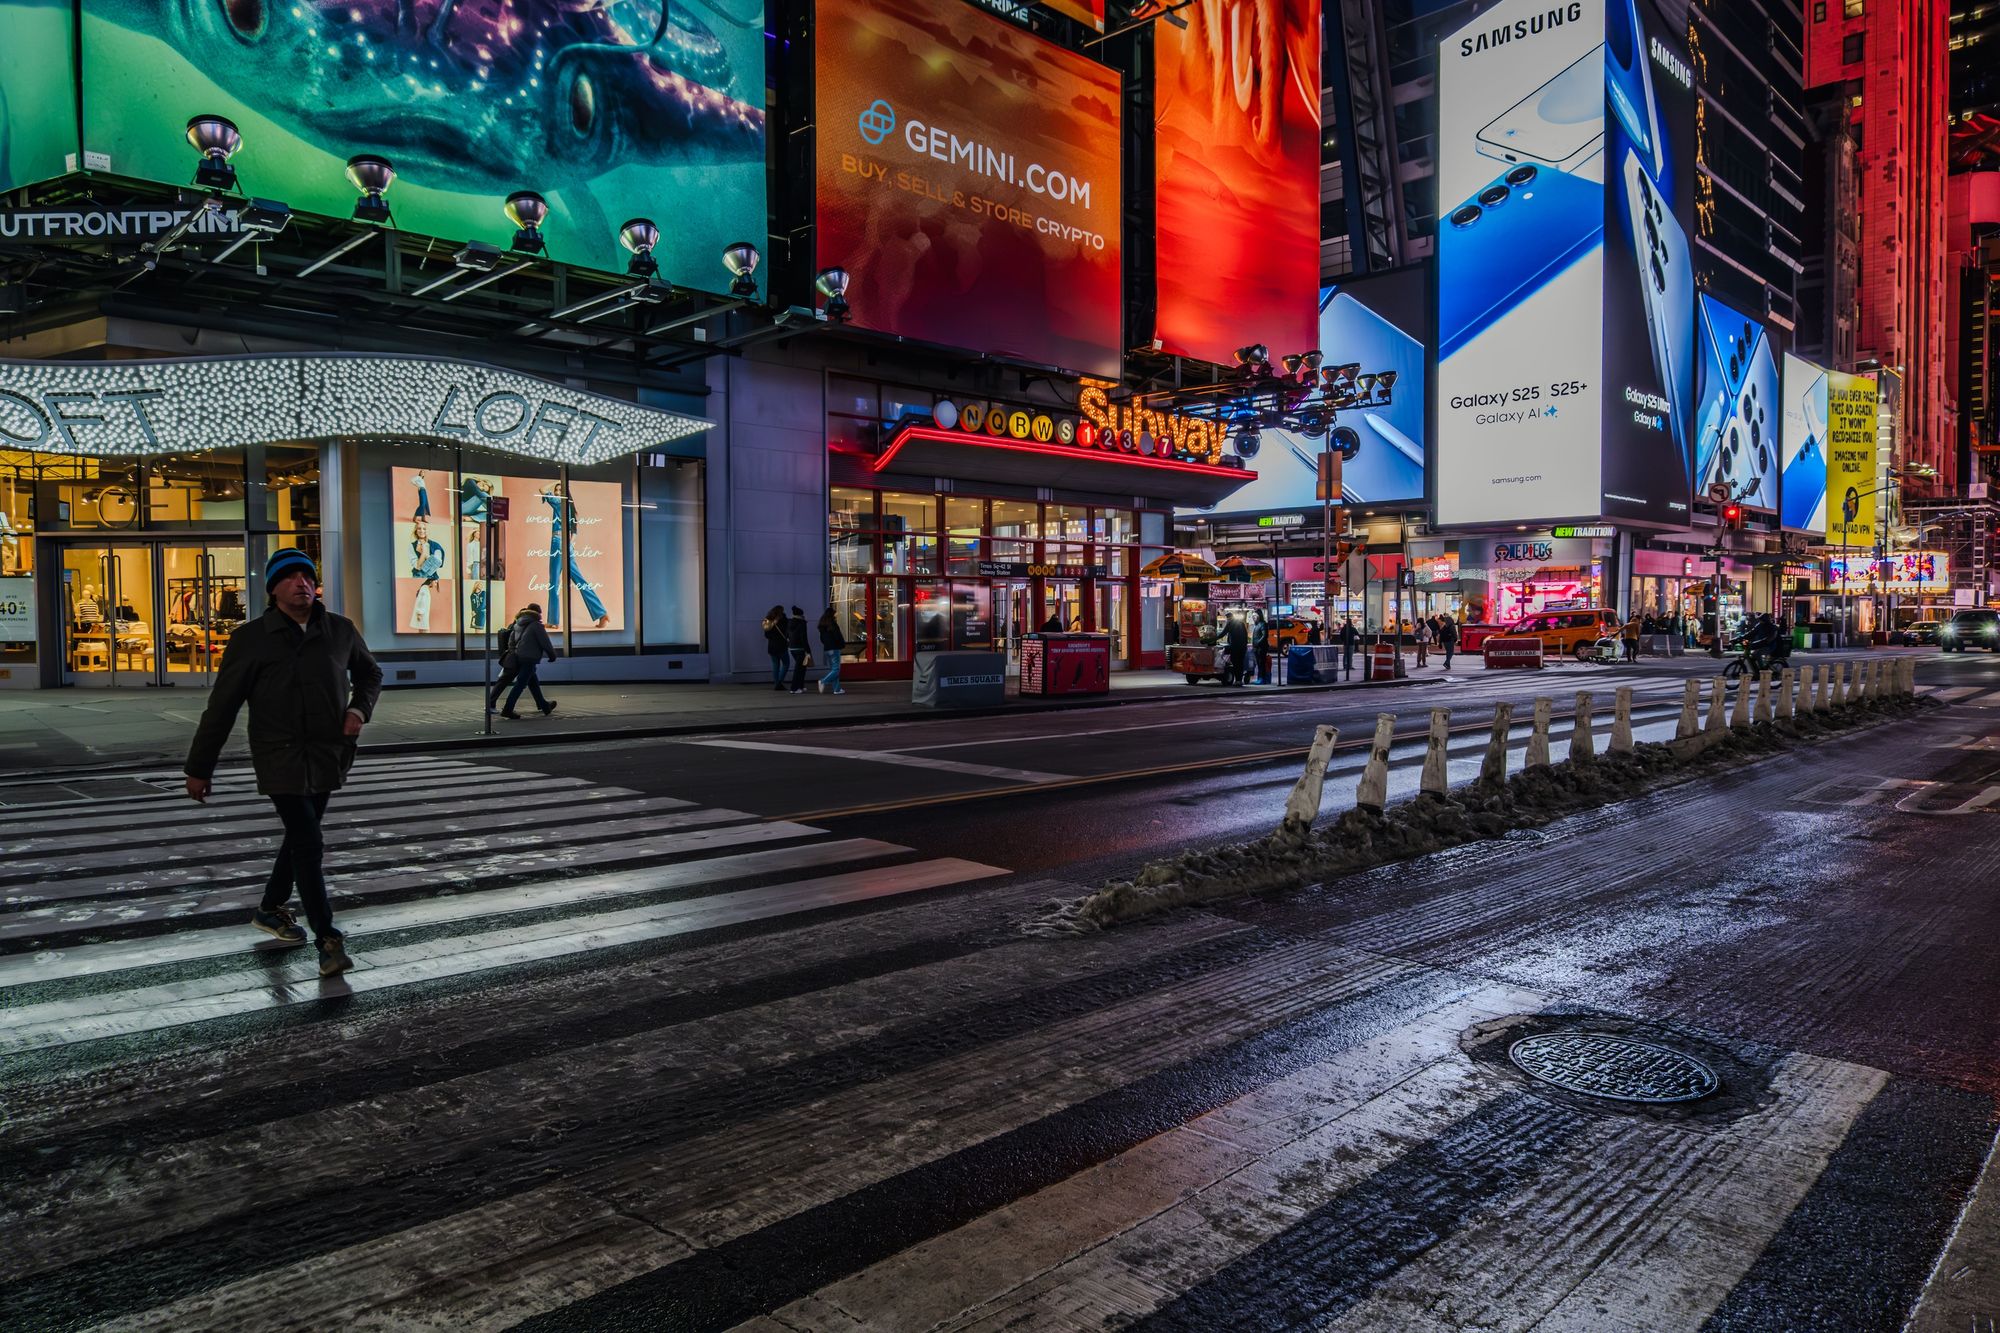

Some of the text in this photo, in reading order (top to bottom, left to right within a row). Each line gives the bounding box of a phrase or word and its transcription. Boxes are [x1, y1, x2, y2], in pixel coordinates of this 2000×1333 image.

[1461, 2, 1582, 57] SAMSUNG
[1651, 37, 1692, 89] SAMSUNG
[905, 120, 1091, 210] GEMINI.COM
[842, 153, 1105, 250] BUY, SELL & STORE CRYPTO
[1451, 381, 1588, 409] Galaxy S25 S25+
[1625, 387, 1648, 410] Galaxy
[1476, 408, 1541, 425] Galaxy AI
[1634, 411, 1652, 429] Galaxy
[1846, 403, 1853, 415] AD
[432, 384, 623, 458] LOFT
[967, 410, 979, 425] N
[992, 412, 1004, 430] Q
[1015, 417, 1026, 432] R
[1036, 419, 1051, 438] W
[1061, 424, 1071, 438] S
[1104, 429, 1113, 446] 2
[1123, 433, 1132, 449] 3
[1161, 438, 1170, 454] 7
[1081, 387, 1229, 465] Subway
[1840, 417, 1847, 429] IT
[1835, 451, 1868, 461] IMAGINE THAT
[1492, 474, 1542, 484] samsung.com
[1832, 523, 1870, 534] MULVAD VPN
[947, 675, 1000, 685] TIMES SQUARE
